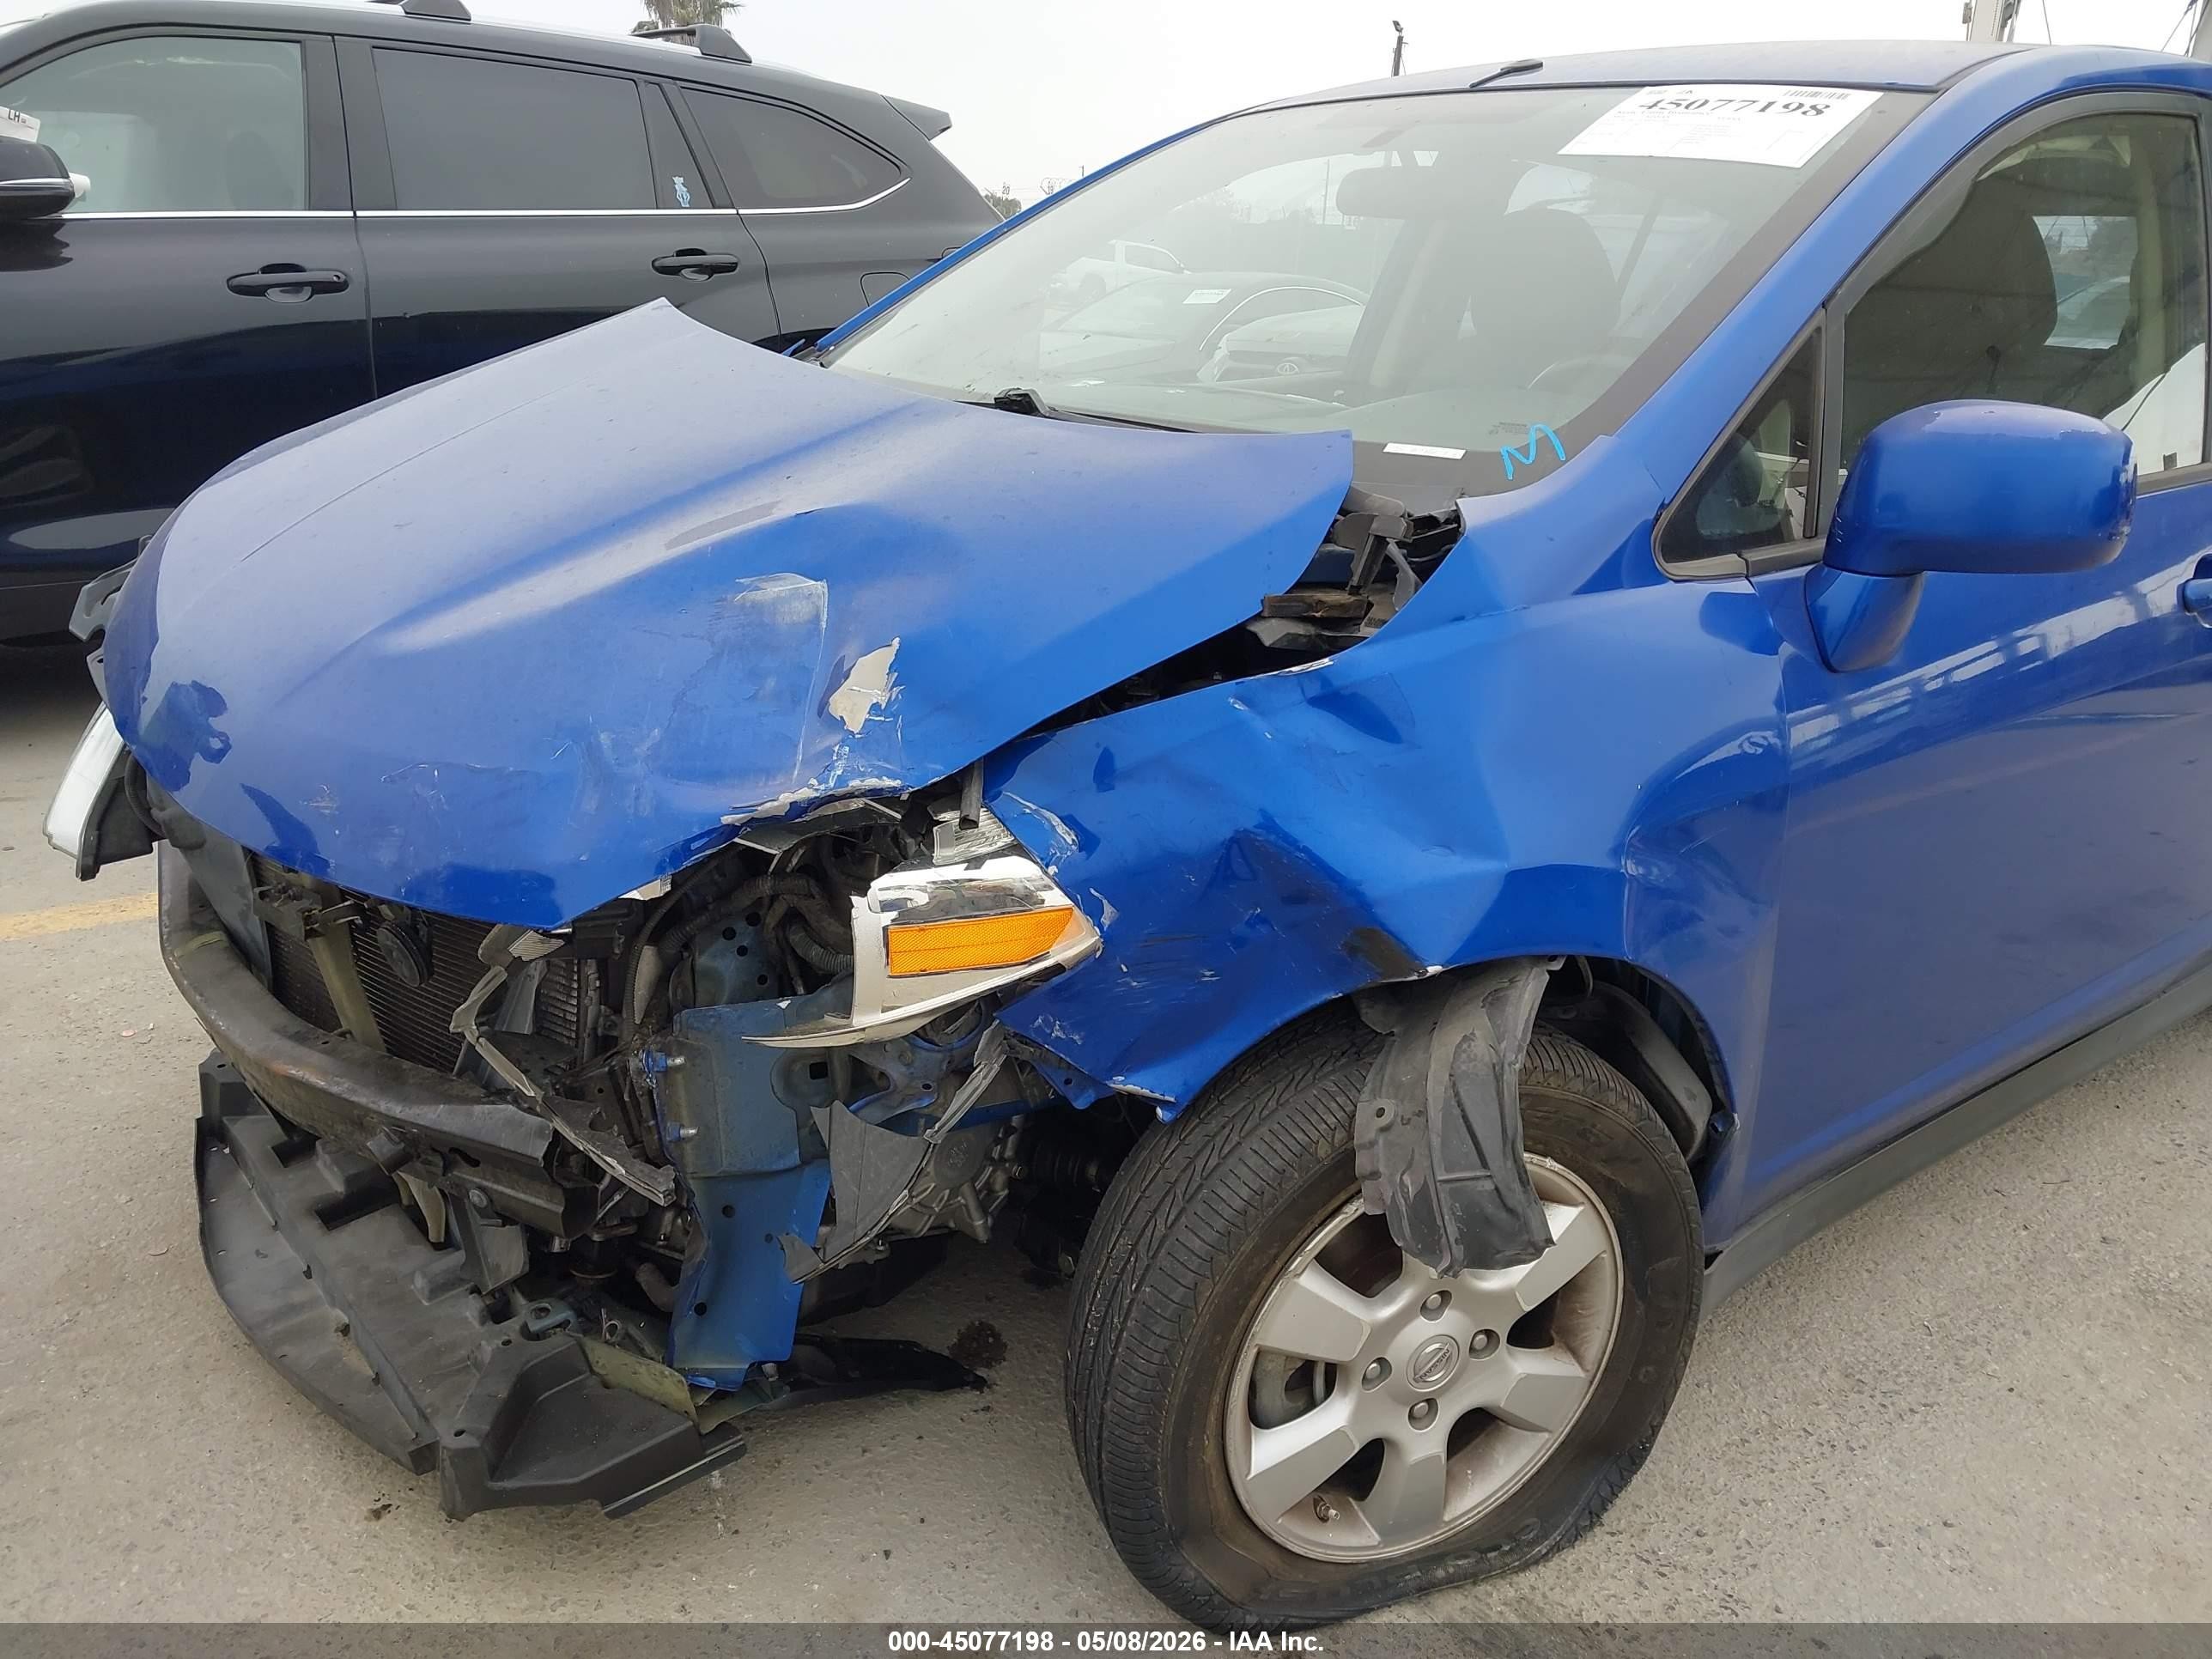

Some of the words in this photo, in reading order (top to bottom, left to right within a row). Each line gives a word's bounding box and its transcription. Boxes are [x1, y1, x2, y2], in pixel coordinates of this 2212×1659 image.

[1638, 98, 1832, 117] 45077198
[1001, 185, 1011, 196] 20
[1419, 1347, 1451, 1381] NISSAN
